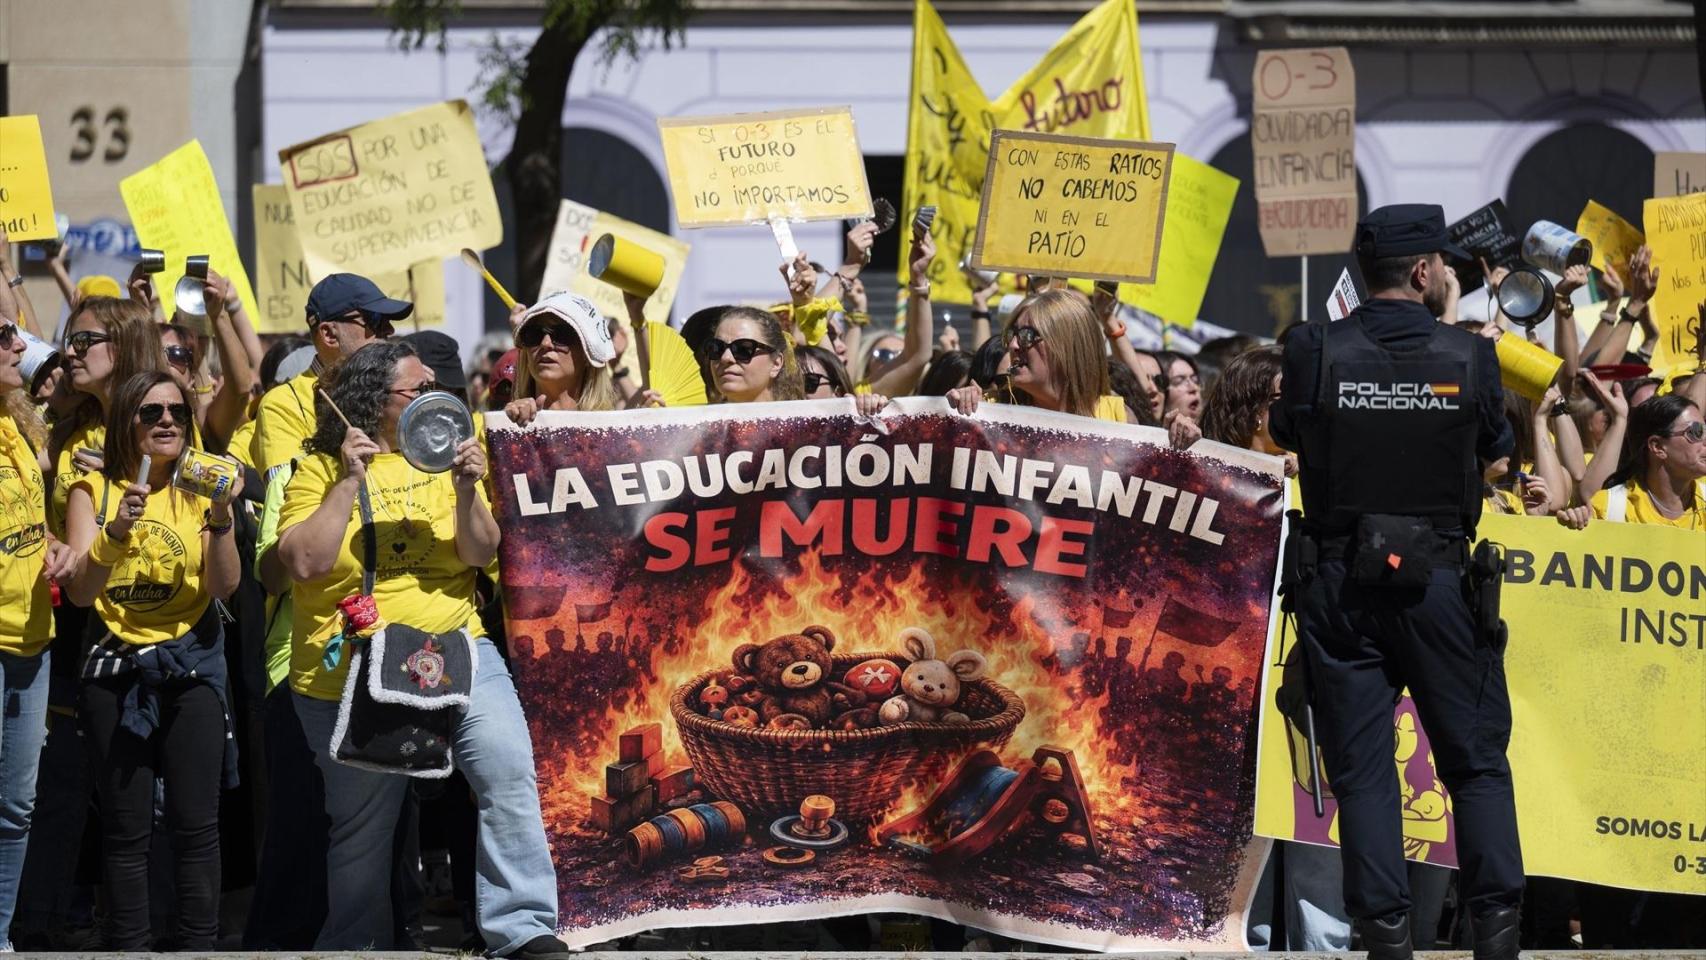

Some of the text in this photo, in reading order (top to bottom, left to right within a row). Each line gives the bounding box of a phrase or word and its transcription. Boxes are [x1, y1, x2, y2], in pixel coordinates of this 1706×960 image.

[1020, 78, 1123, 132] futuro
[69, 105, 130, 163] 33
[784, 121, 803, 139] ES
[815, 120, 833, 135] EL
[296, 123, 449, 182] SOS POR UNA
[718, 141, 796, 162] FUTURO
[427, 159, 450, 180] DE
[1008, 149, 1162, 180] CON ESTAS RATIOS
[694, 191, 721, 208] NO
[1018, 177, 1137, 202] NO CABEMOS
[314, 181, 476, 239] CALIDAD NO DE
[1061, 210, 1080, 226] EN
[1095, 212, 1110, 227] EL
[1339, 382, 1435, 396] POLICIA
[1338, 396, 1460, 410] NACIONAL
[512, 433, 1226, 546] LA EDUCACIÓN INFANTIL
[149, 525, 161, 536] DE
[161, 529, 184, 557] VIENTO
[643, 496, 1095, 577] SE MUERE
[114, 582, 167, 600] en lucha
[1620, 607, 1706, 650] INST
[1595, 816, 1682, 840] SOMOS
